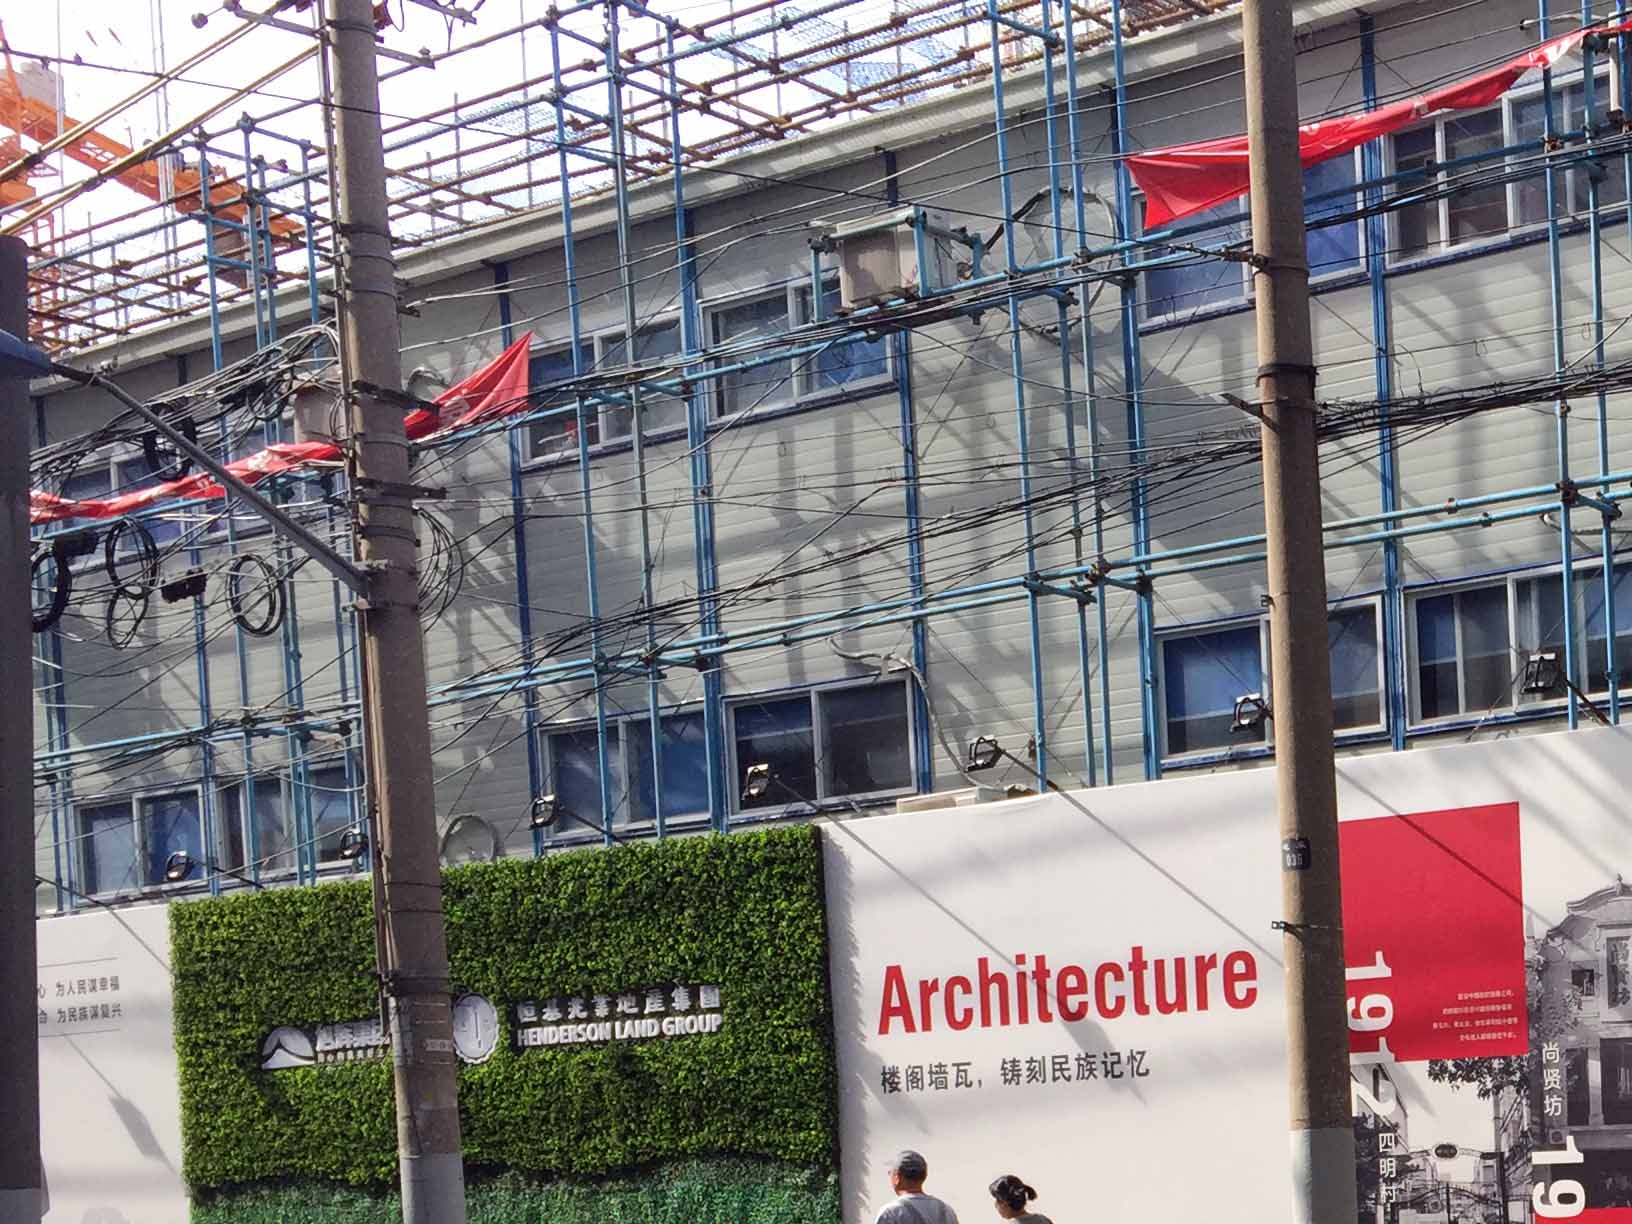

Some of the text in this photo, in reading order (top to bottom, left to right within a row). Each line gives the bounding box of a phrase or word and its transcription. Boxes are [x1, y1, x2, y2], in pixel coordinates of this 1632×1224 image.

[877, 946, 1258, 1036] Architecture
[516, 1021, 612, 1047] HENDERSON
[614, 1018, 660, 1040] LAND
[661, 1013, 723, 1037] GROUP
[1345, 950, 1396, 1117] 1912
[1541, 1041, 1563, 1117] 尚贤坊
[1378, 1132, 1399, 1205] 四明村
